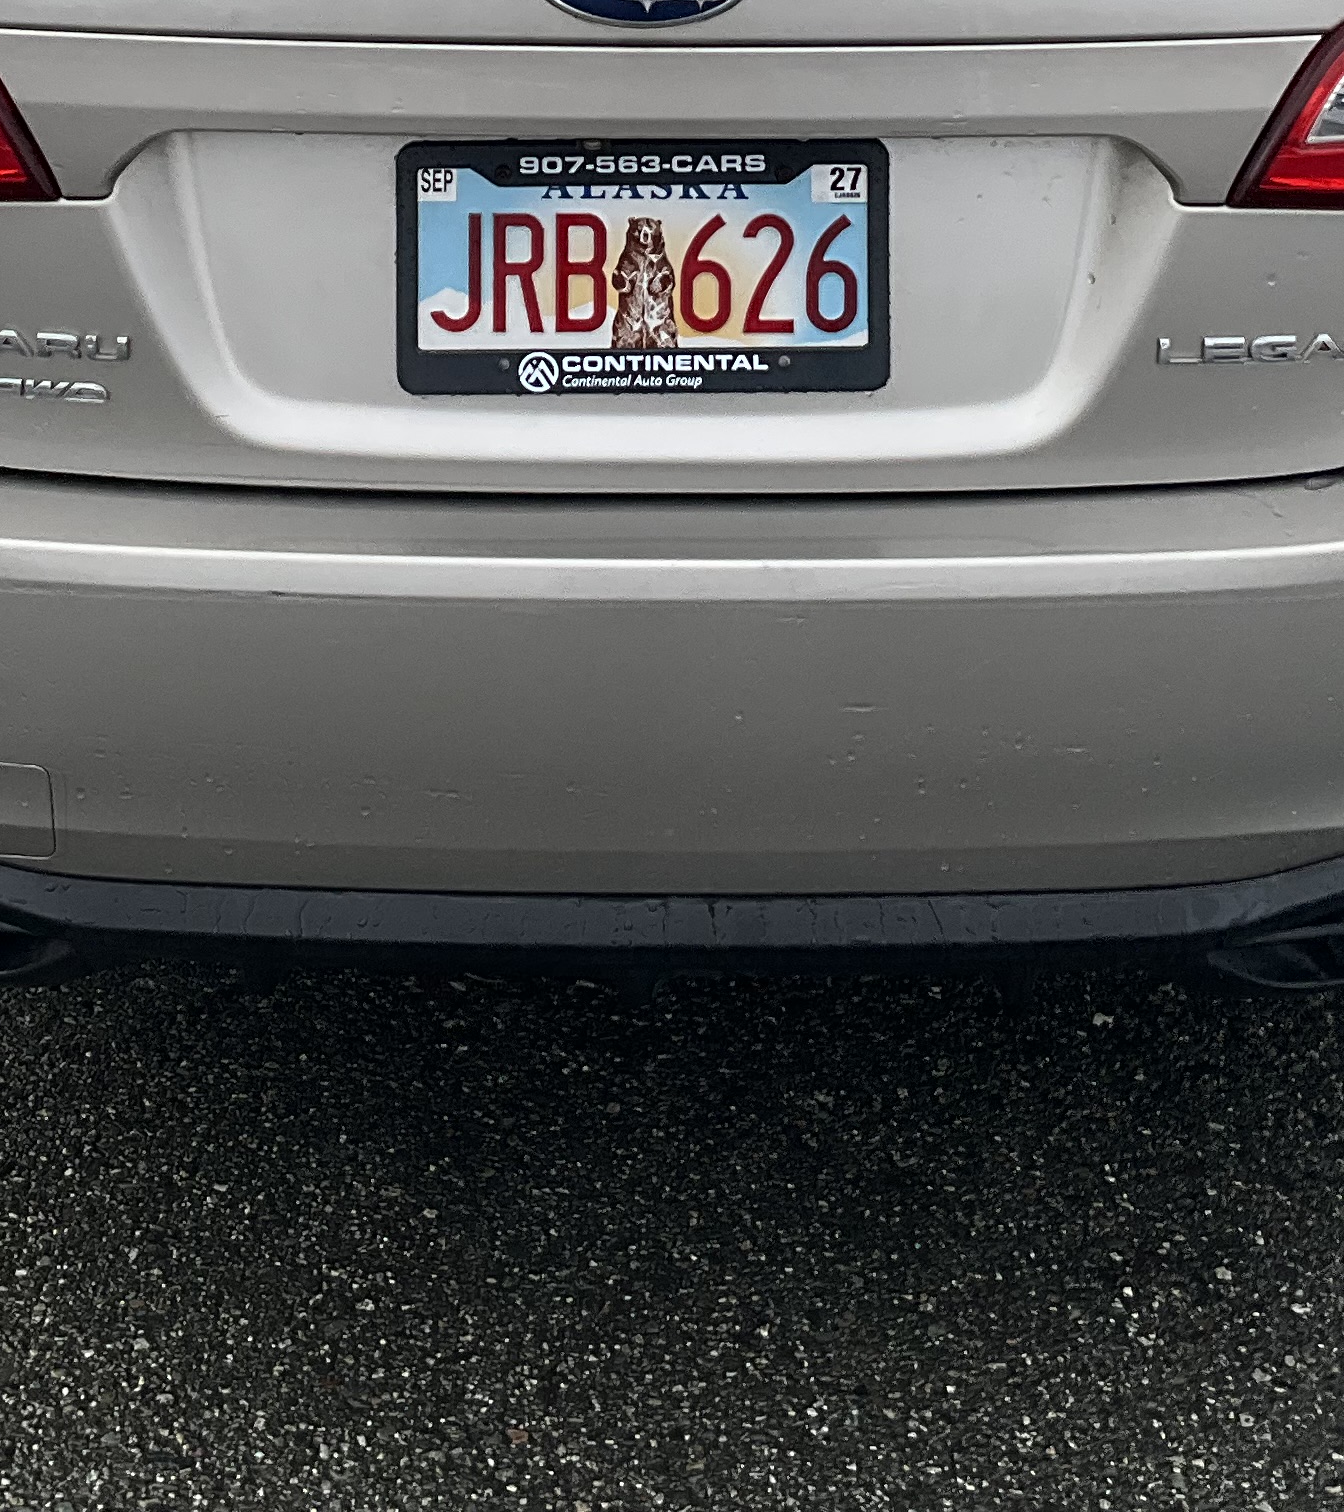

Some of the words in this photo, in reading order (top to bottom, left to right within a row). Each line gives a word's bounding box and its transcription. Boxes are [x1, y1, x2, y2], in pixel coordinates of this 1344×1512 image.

[518, 153, 767, 175] 907-563-CARS
[420, 168, 454, 193] SEP
[829, 166, 862, 191] 27
[430, 211, 608, 334] JRB
[679, 212, 859, 334] 626
[562, 354, 769, 373] CONTINENTAL
[562, 374, 631, 388] Continental
[634, 375, 663, 388] Auto
[665, 374, 703, 390] Group
